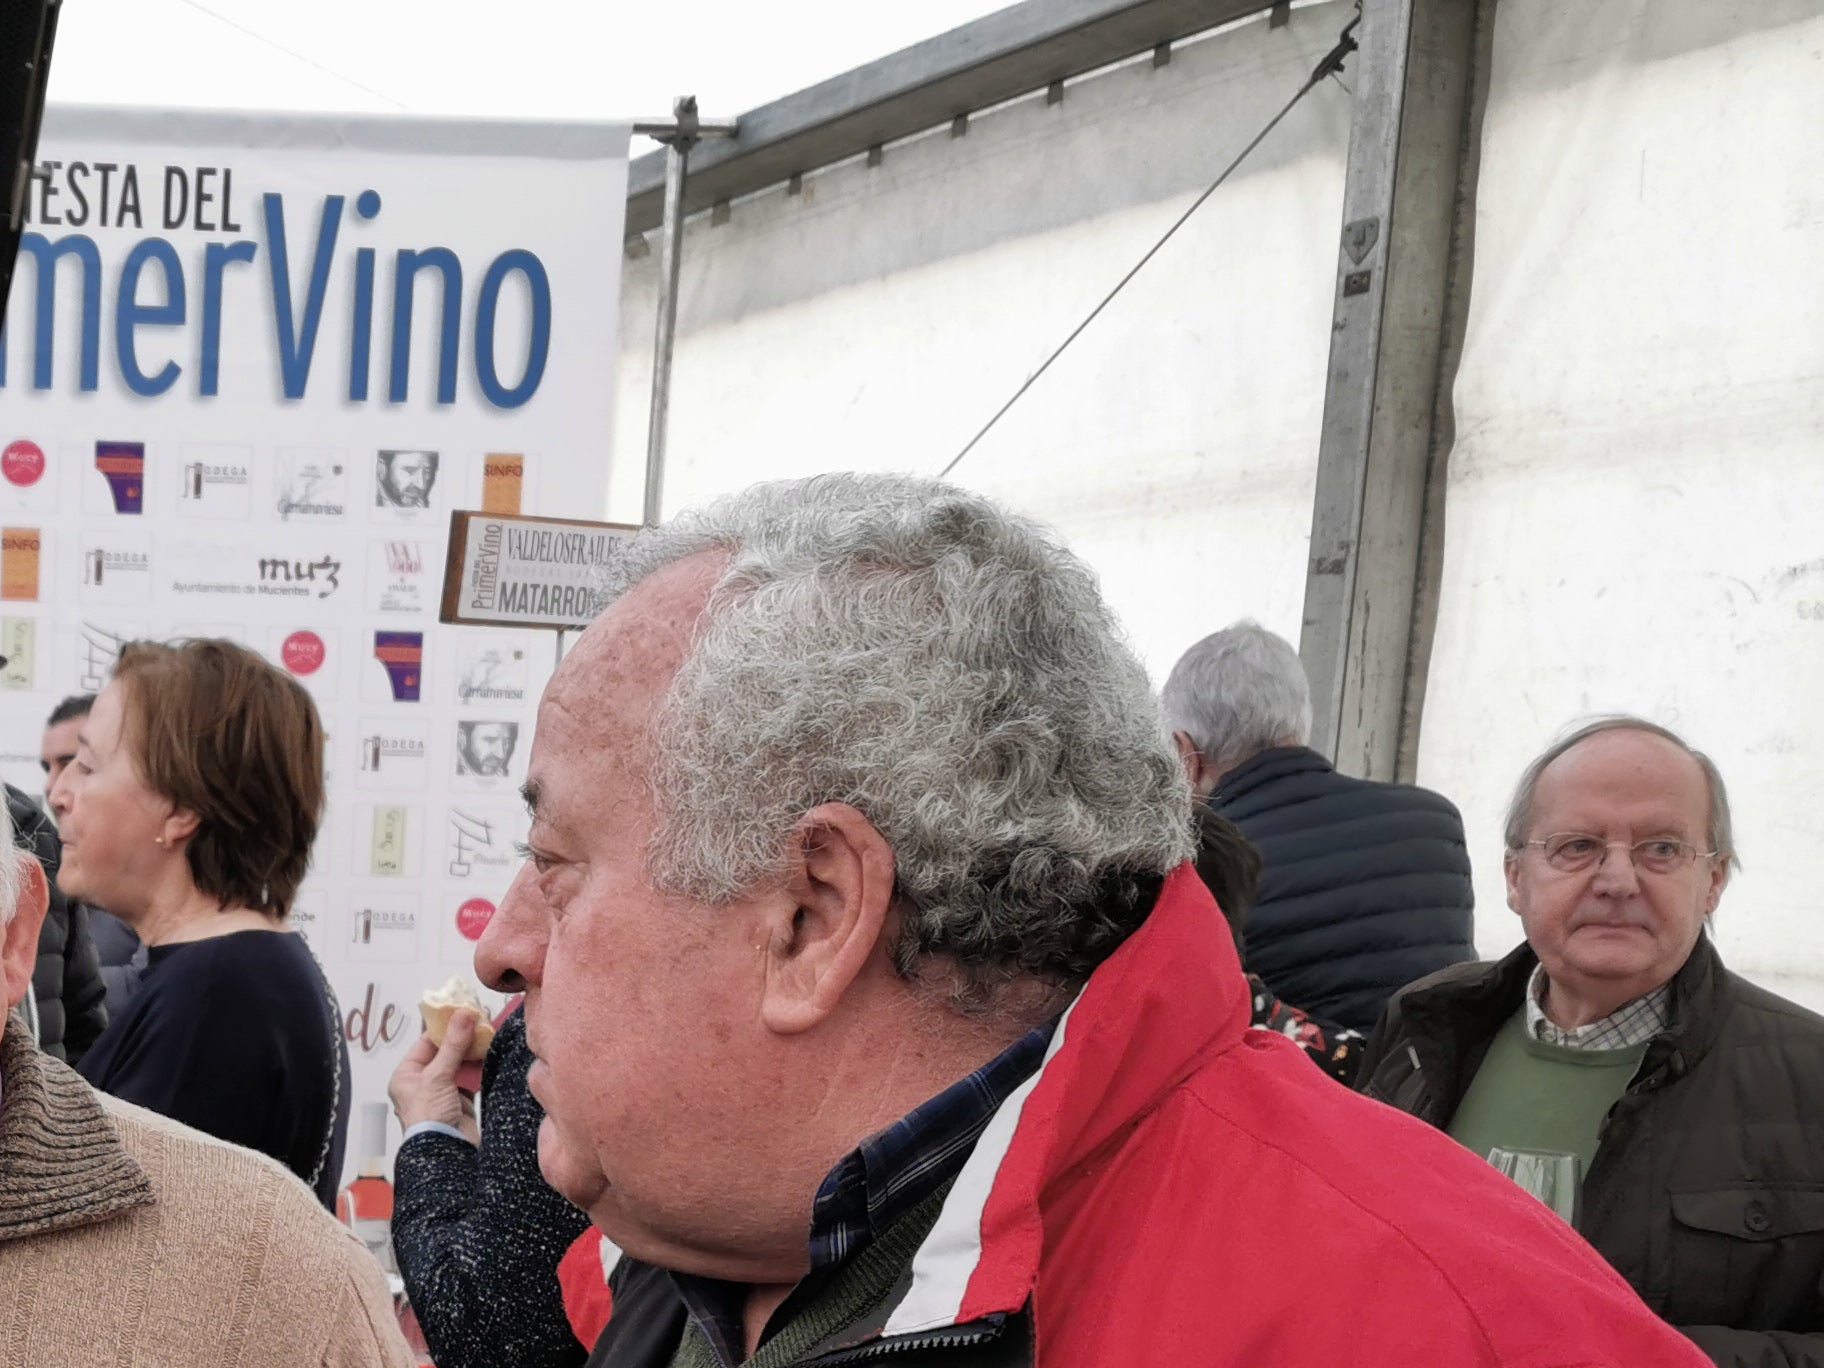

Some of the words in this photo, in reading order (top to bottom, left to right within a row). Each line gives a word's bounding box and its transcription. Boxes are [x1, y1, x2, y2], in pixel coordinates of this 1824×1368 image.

[25, 160, 143, 229] ESTA
[163, 165, 241, 233] DEL
[471, 523, 503, 610] PrimerVino
[508, 527, 622, 567] VALDELOSFRAILE
[173, 582, 242, 595] Ayuntamiento
[243, 583, 256, 595] de
[258, 584, 310, 597] Mucientes
